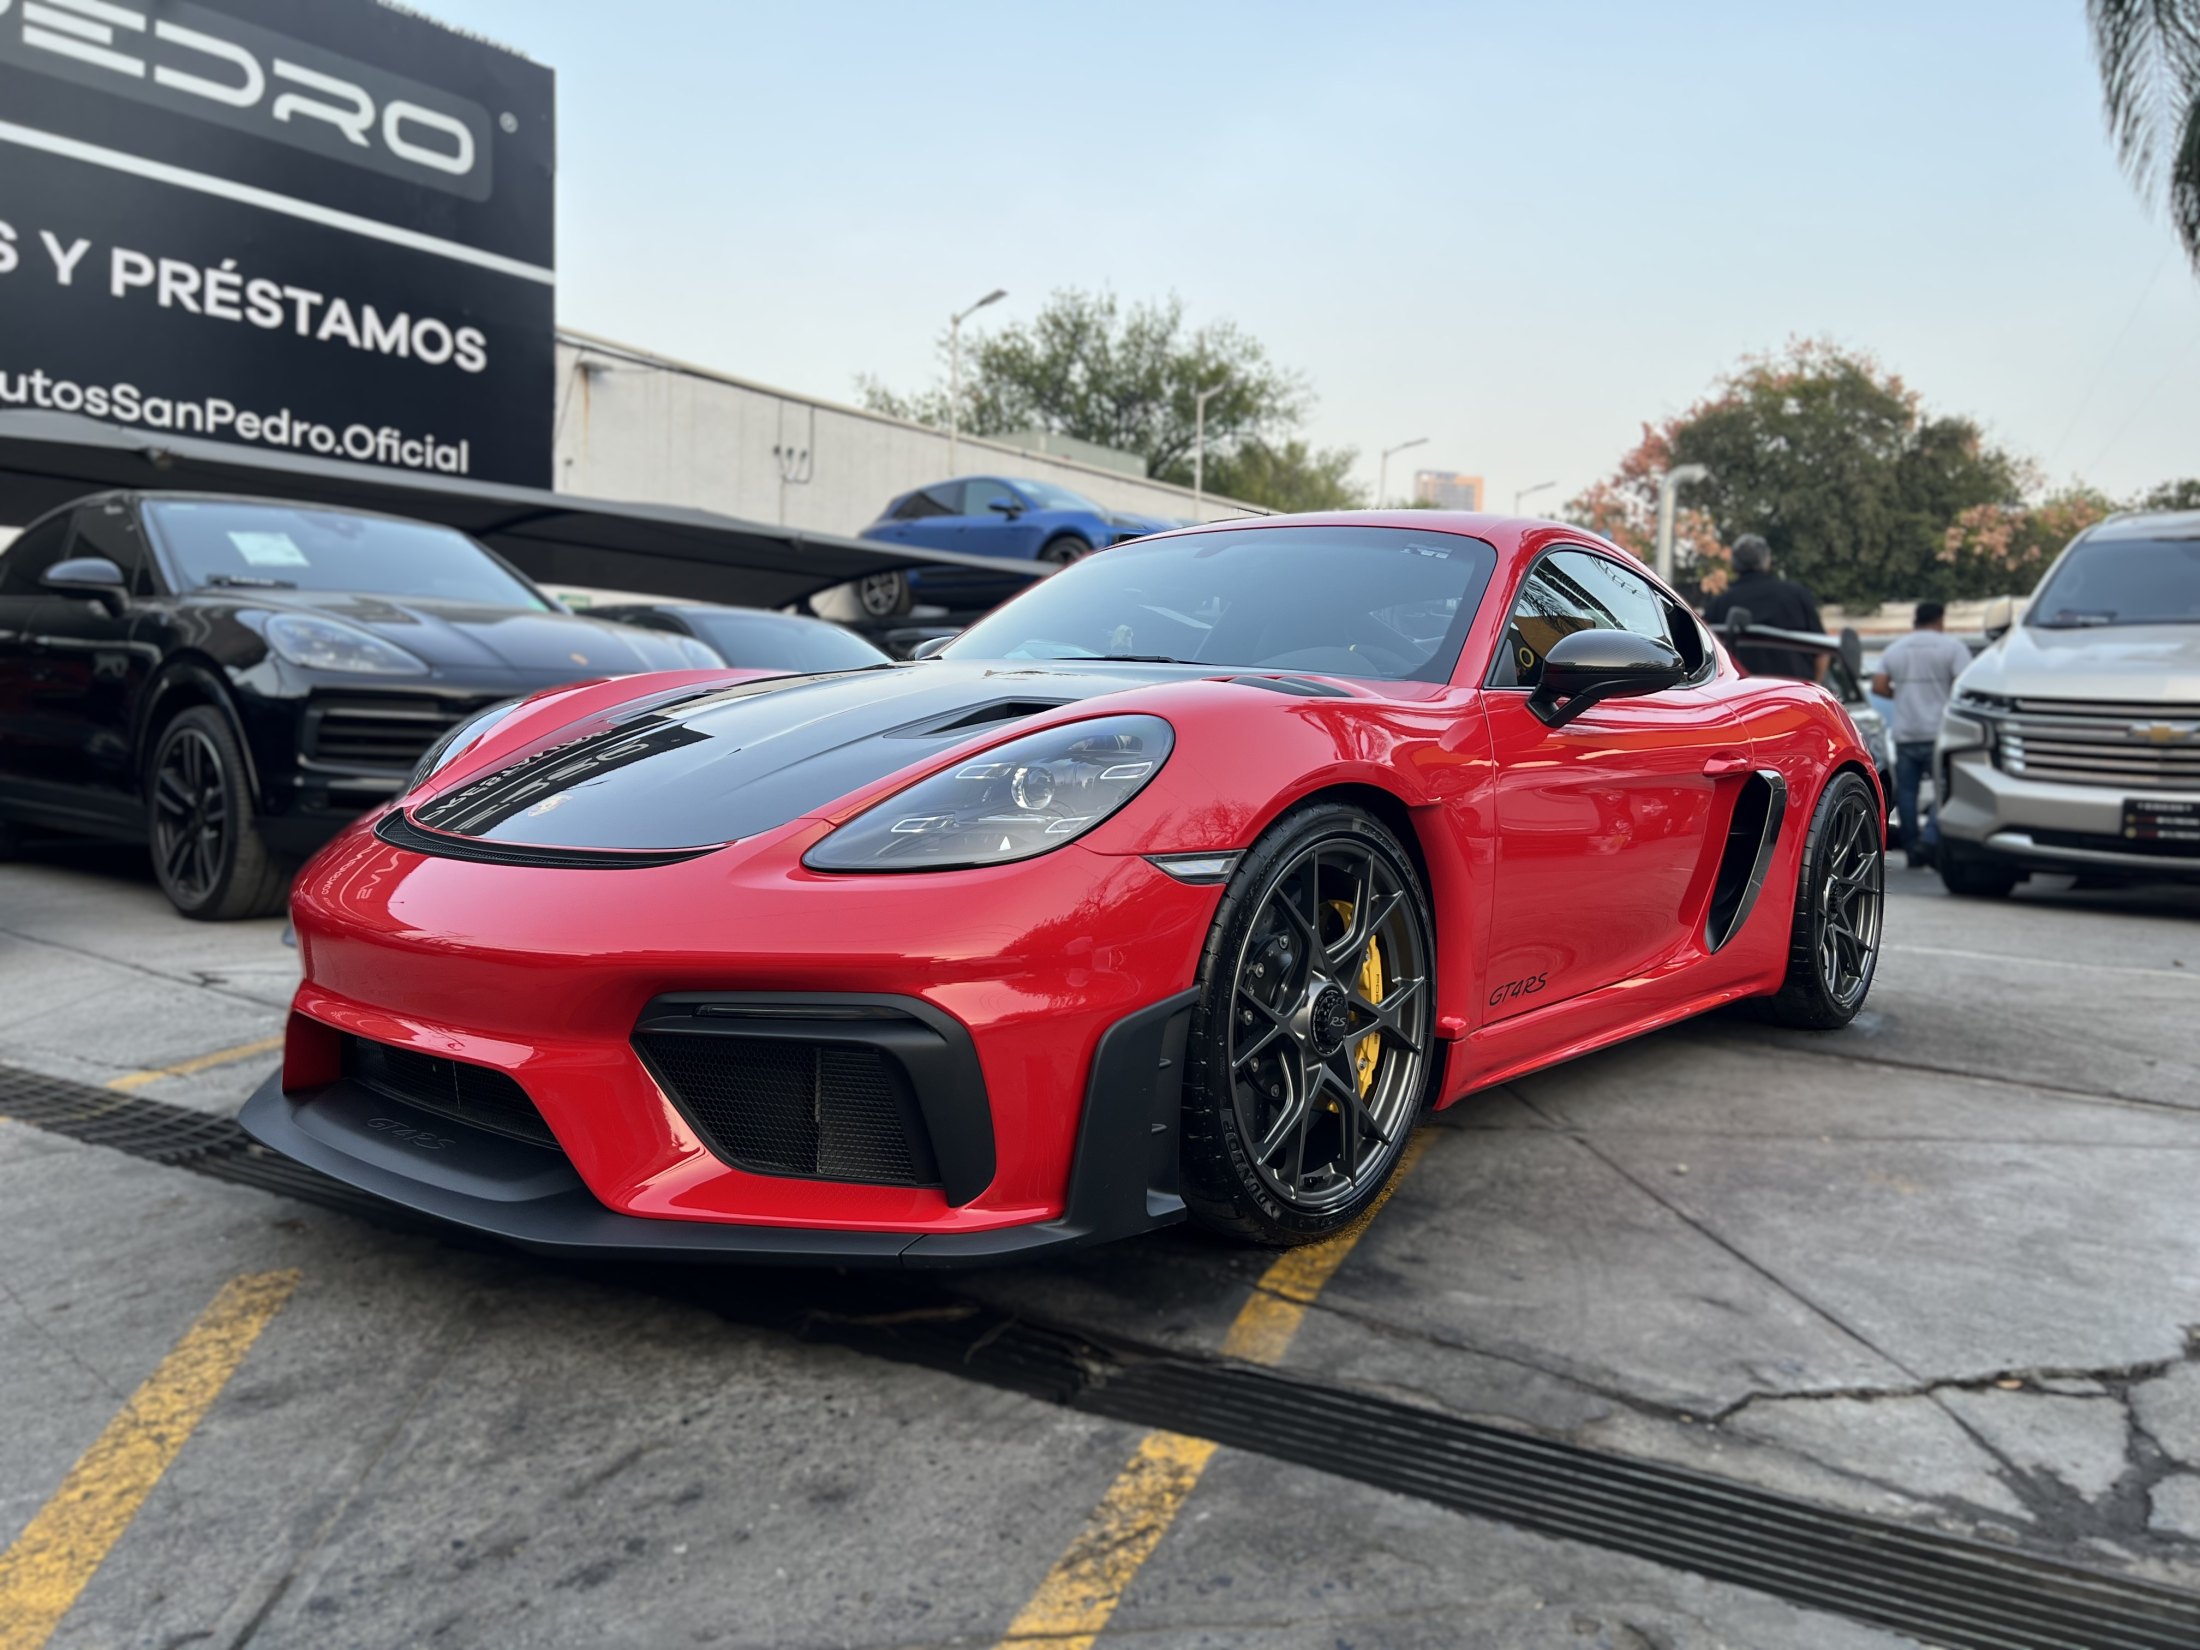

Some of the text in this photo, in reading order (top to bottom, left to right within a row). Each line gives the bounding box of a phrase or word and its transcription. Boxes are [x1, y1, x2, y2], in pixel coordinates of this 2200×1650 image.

[0, 0, 475, 175] EDRO
[38, 229, 92, 286] Y
[110, 246, 488, 373] PRÉSTAMOS
[1489, 972, 1548, 1006] GT4RS
[1222, 1120, 1268, 1206] DUNLOP
